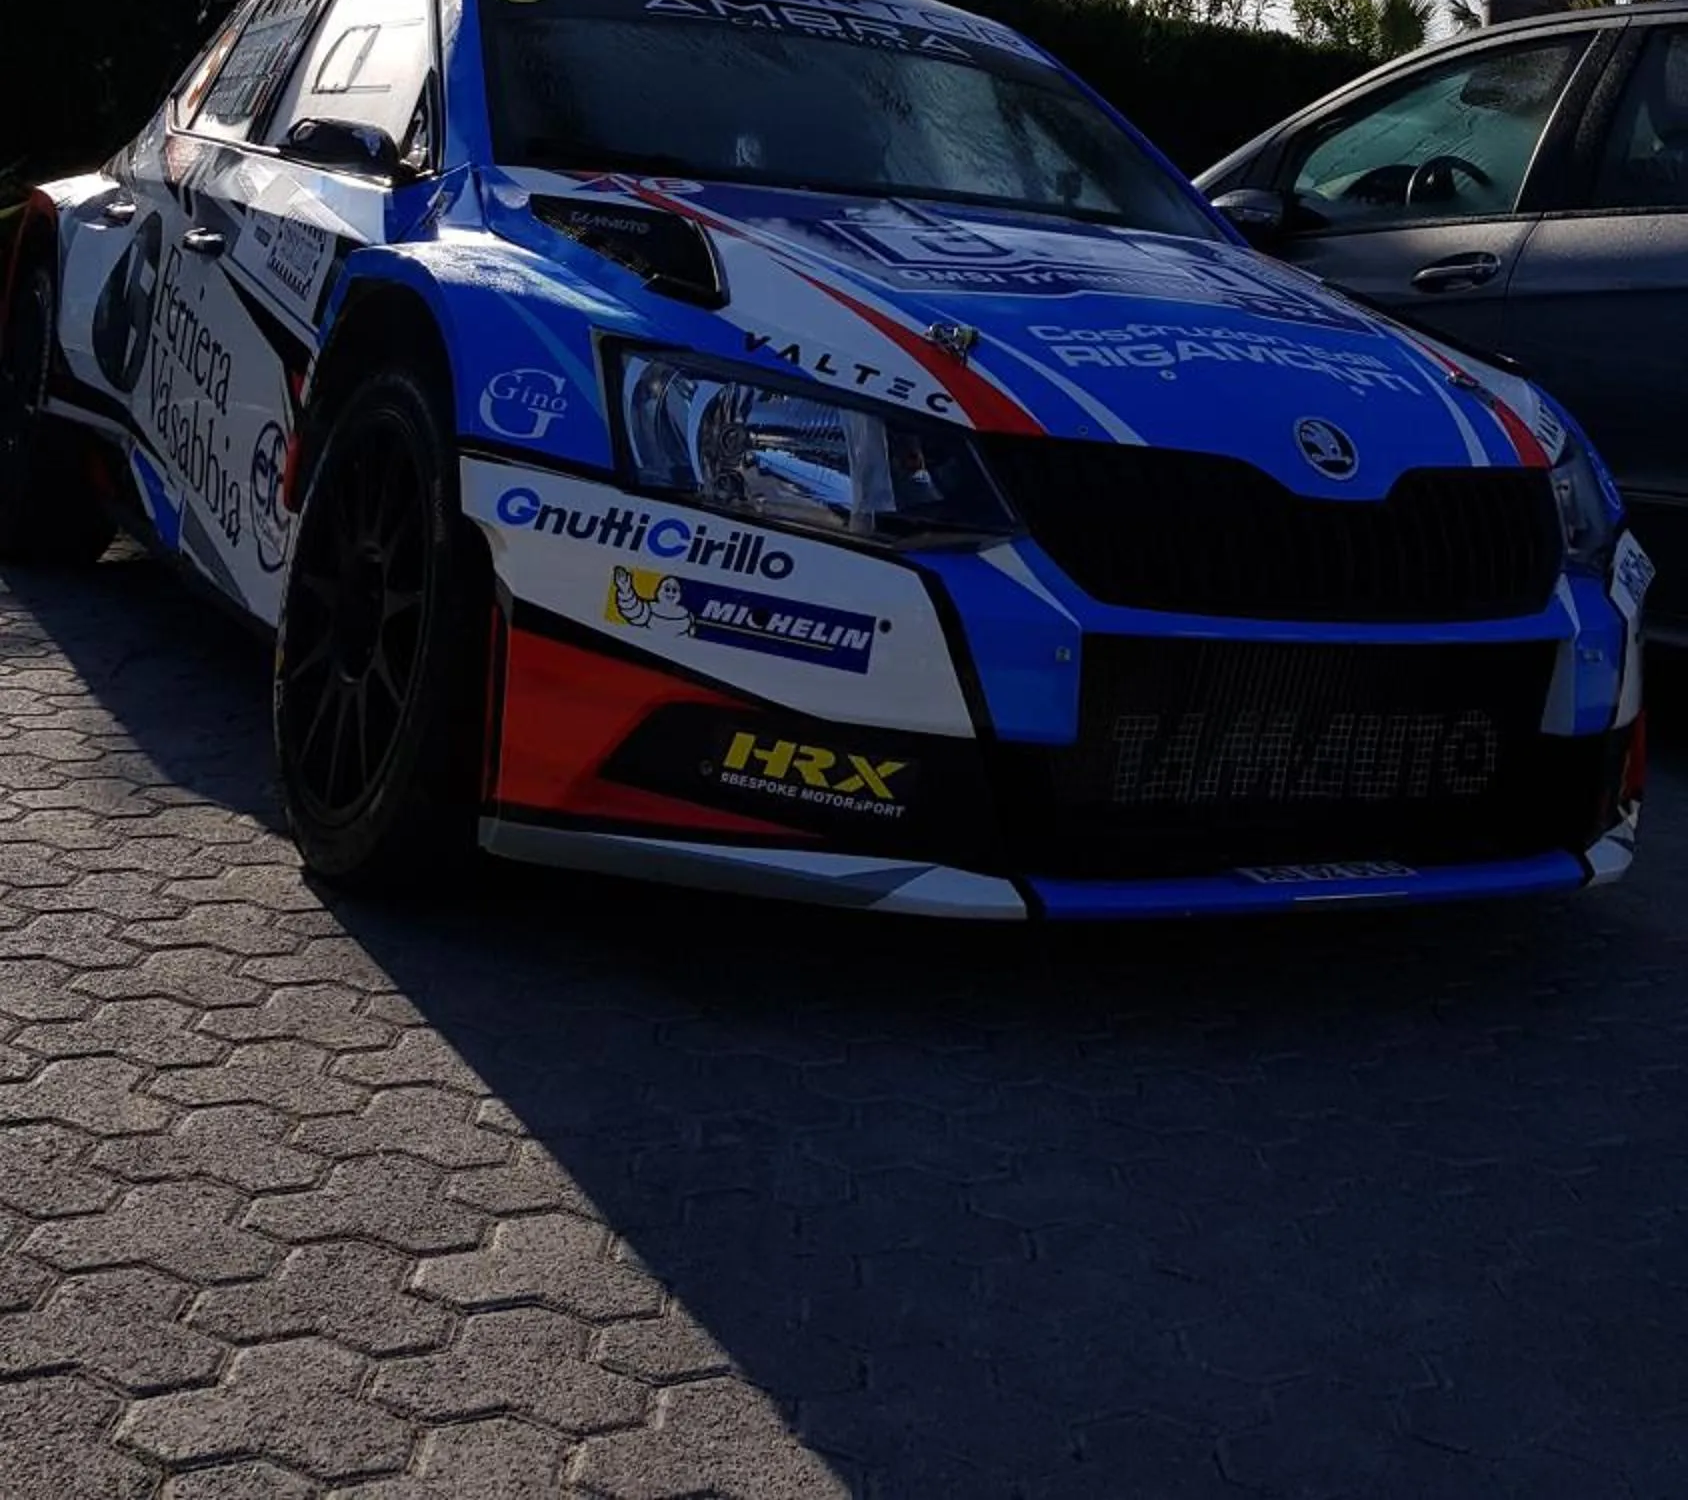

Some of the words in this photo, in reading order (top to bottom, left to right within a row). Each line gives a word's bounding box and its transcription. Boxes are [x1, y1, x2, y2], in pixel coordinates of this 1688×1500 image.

[488, 371, 569, 412] Gino
[744, 331, 954, 414] VALTEC
[722, 730, 910, 801] HRX
